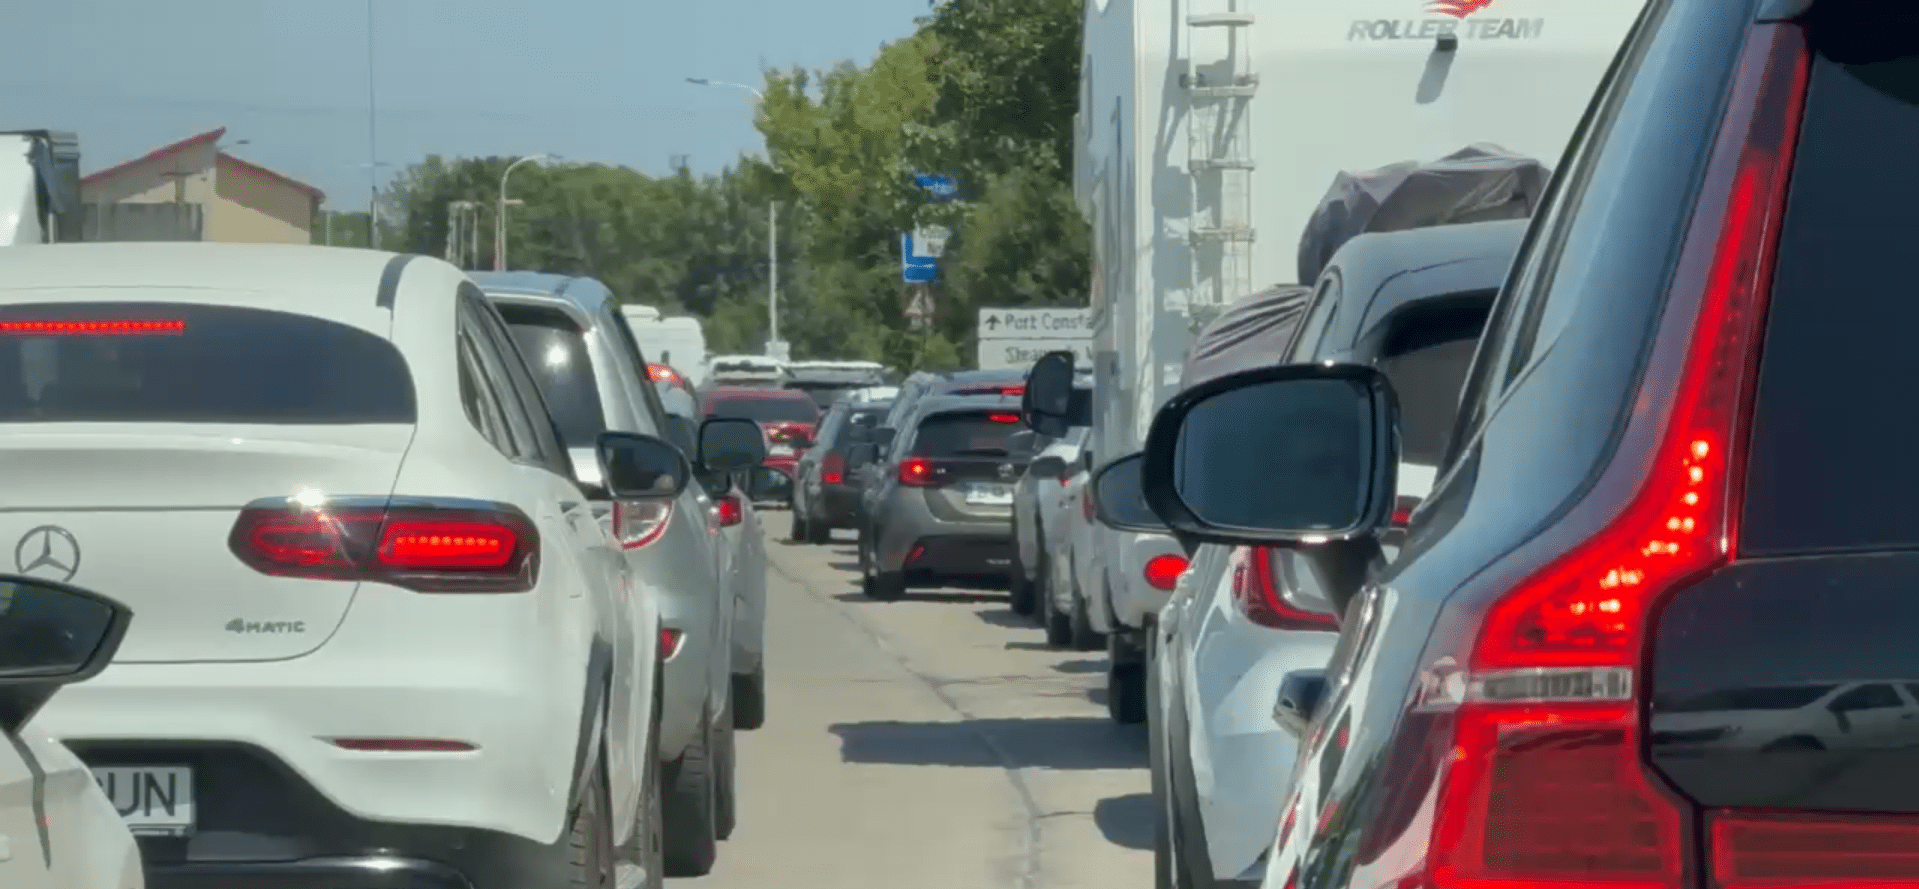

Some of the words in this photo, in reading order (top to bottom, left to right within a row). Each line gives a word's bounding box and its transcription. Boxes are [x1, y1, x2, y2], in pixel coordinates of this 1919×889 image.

[1347, 19, 1459, 40] ROLLER
[1466, 18, 1544, 40] TEAM
[1005, 313, 1037, 330] Port
[1041, 312, 1093, 330] Consta
[225, 618, 306, 634] 4MATIC
[98, 771, 177, 817] UN
